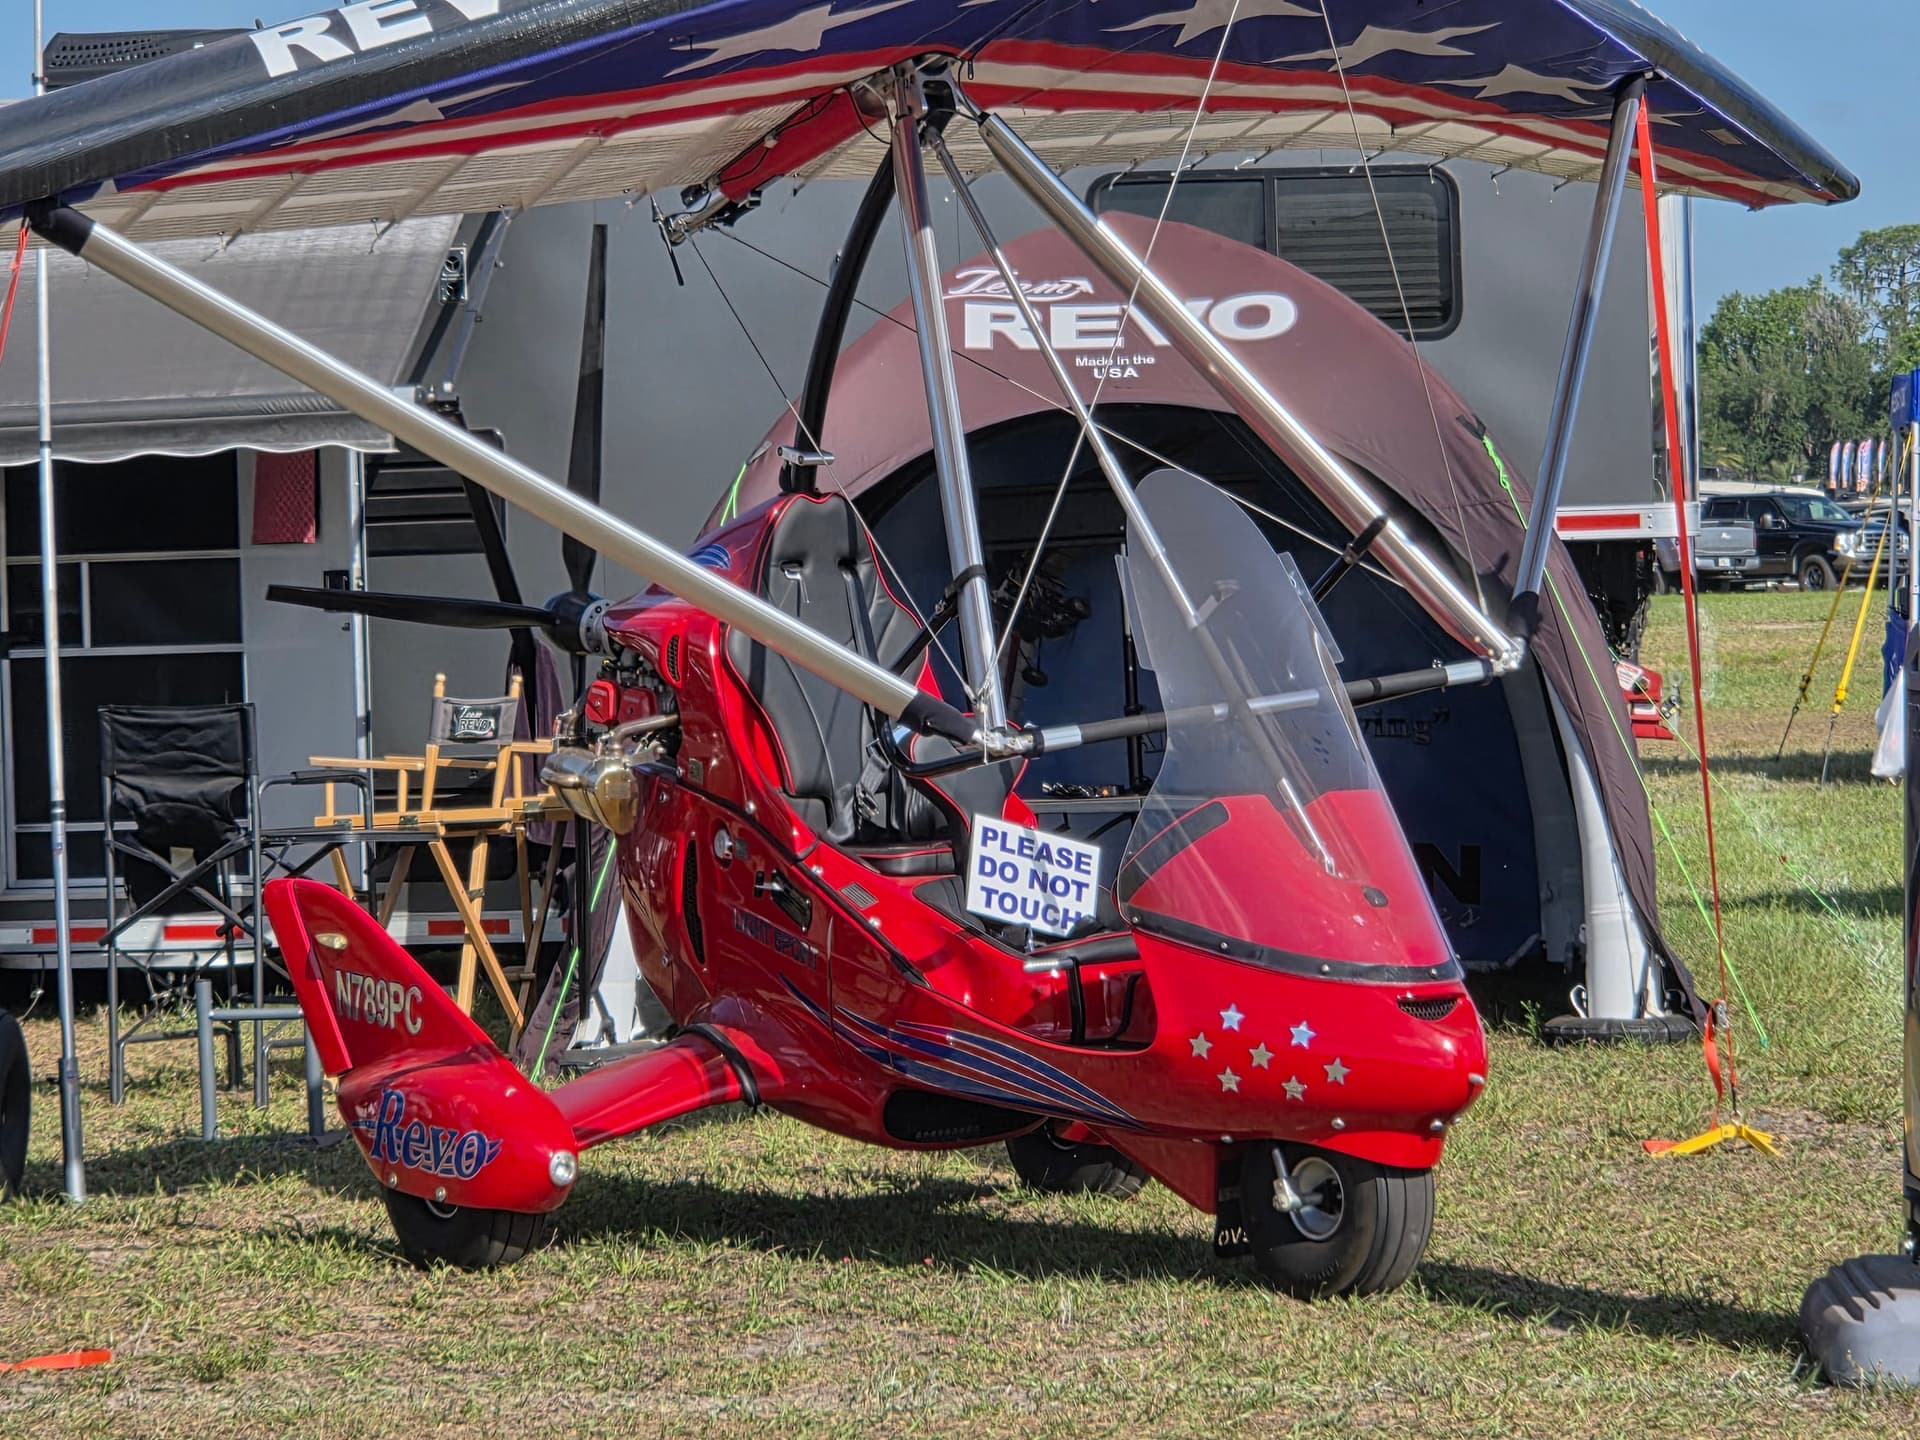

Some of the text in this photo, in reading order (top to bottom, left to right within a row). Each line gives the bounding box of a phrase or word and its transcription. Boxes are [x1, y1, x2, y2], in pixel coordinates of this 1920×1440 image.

[964, 293, 1298, 350] REVO
[1075, 355, 1113, 367] Made
[1133, 354, 1155, 365] the
[1093, 366, 1140, 379] USA
[980, 825, 1093, 876] PLEASE
[978, 854, 1090, 903] DO NOT
[980, 885, 1083, 930] TOUCH
[335, 968, 424, 1037] N789PC
[367, 1085, 490, 1181] Revo
